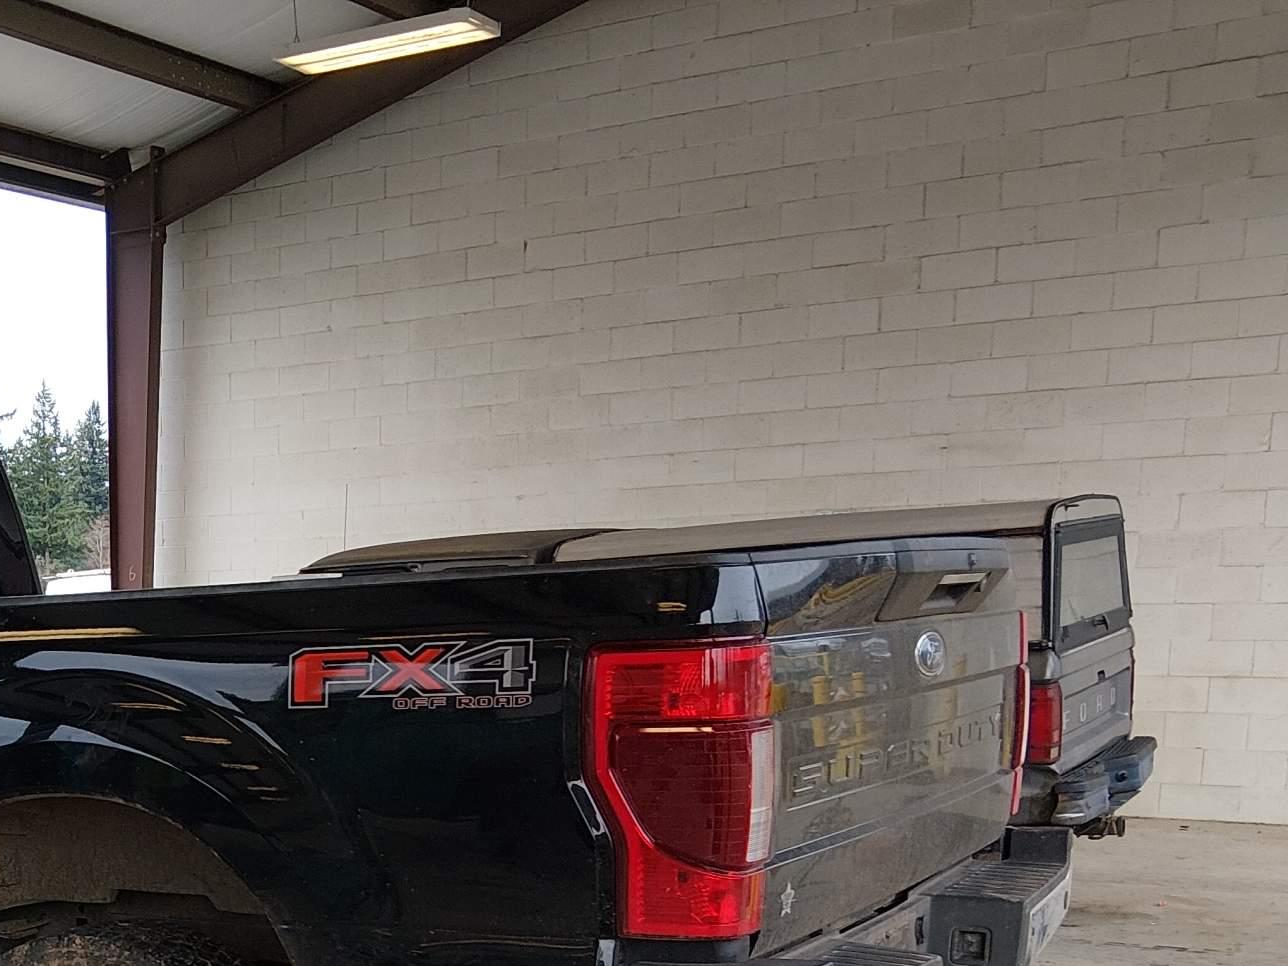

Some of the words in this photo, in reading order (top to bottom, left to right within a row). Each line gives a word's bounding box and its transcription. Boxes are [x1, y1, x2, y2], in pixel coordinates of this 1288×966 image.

[288, 638, 536, 709] FX4
[392, 696, 447, 710] OFF
[455, 694, 533, 709] ROAD
[1063, 687, 1116, 730] FORD
[792, 739, 930, 798] SUPER
[937, 711, 1002, 756] DUTY
